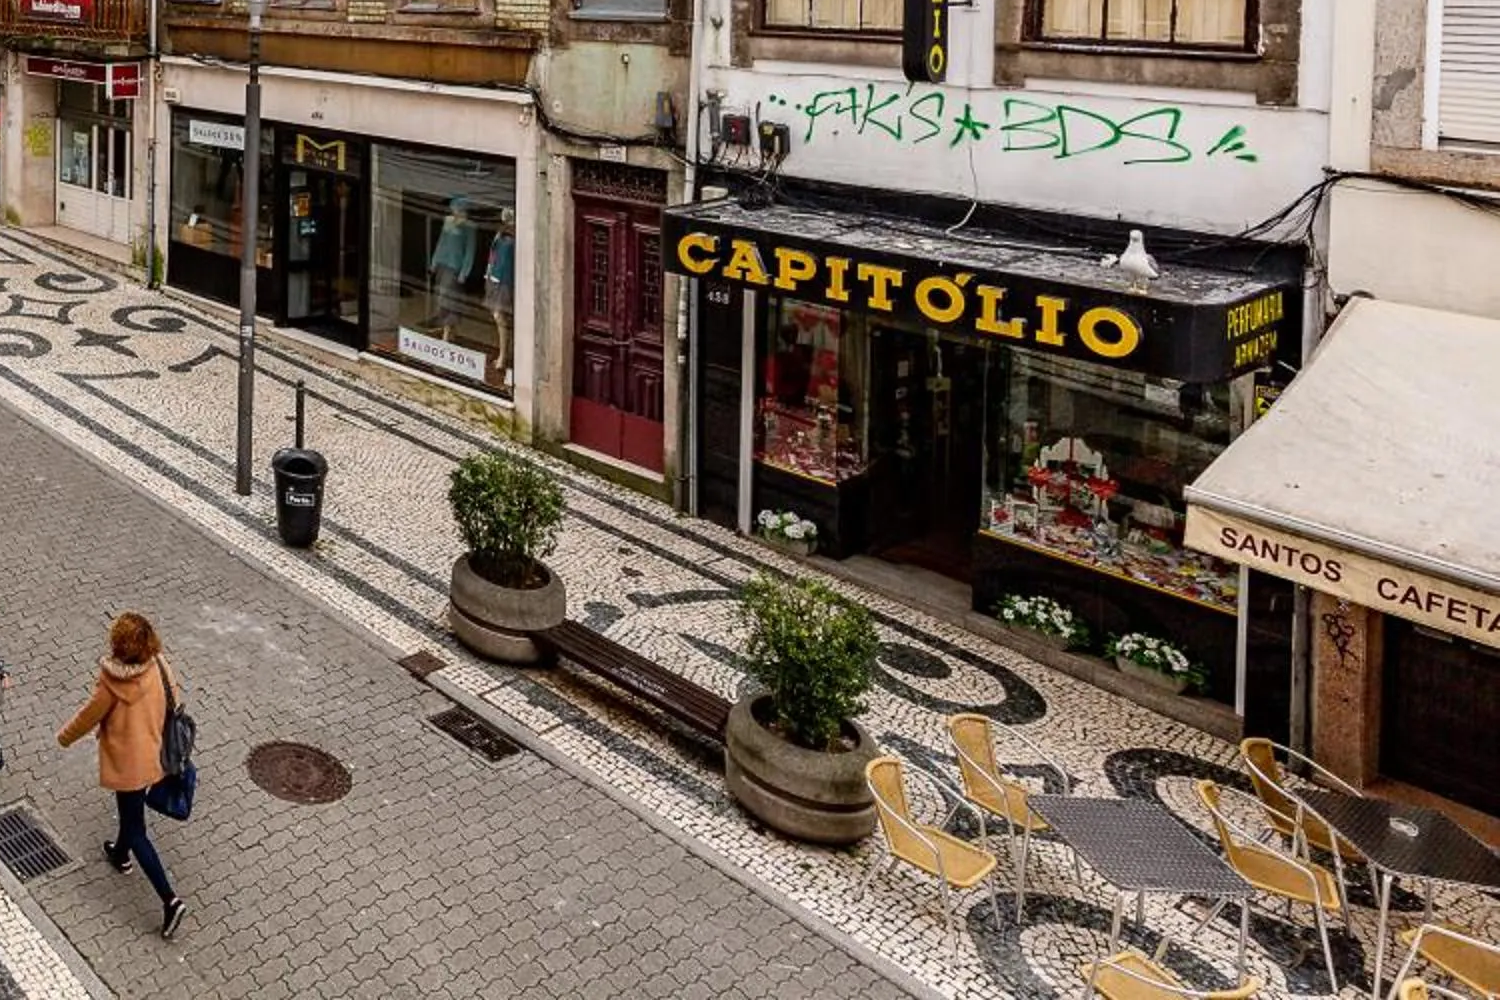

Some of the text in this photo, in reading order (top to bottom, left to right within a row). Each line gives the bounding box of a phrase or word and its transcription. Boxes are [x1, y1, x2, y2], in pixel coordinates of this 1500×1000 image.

[677, 232, 1143, 358] CAPITÓLIO
[403, 337, 445, 359] SALDOS
[1219, 527, 1343, 583] SANTOS
